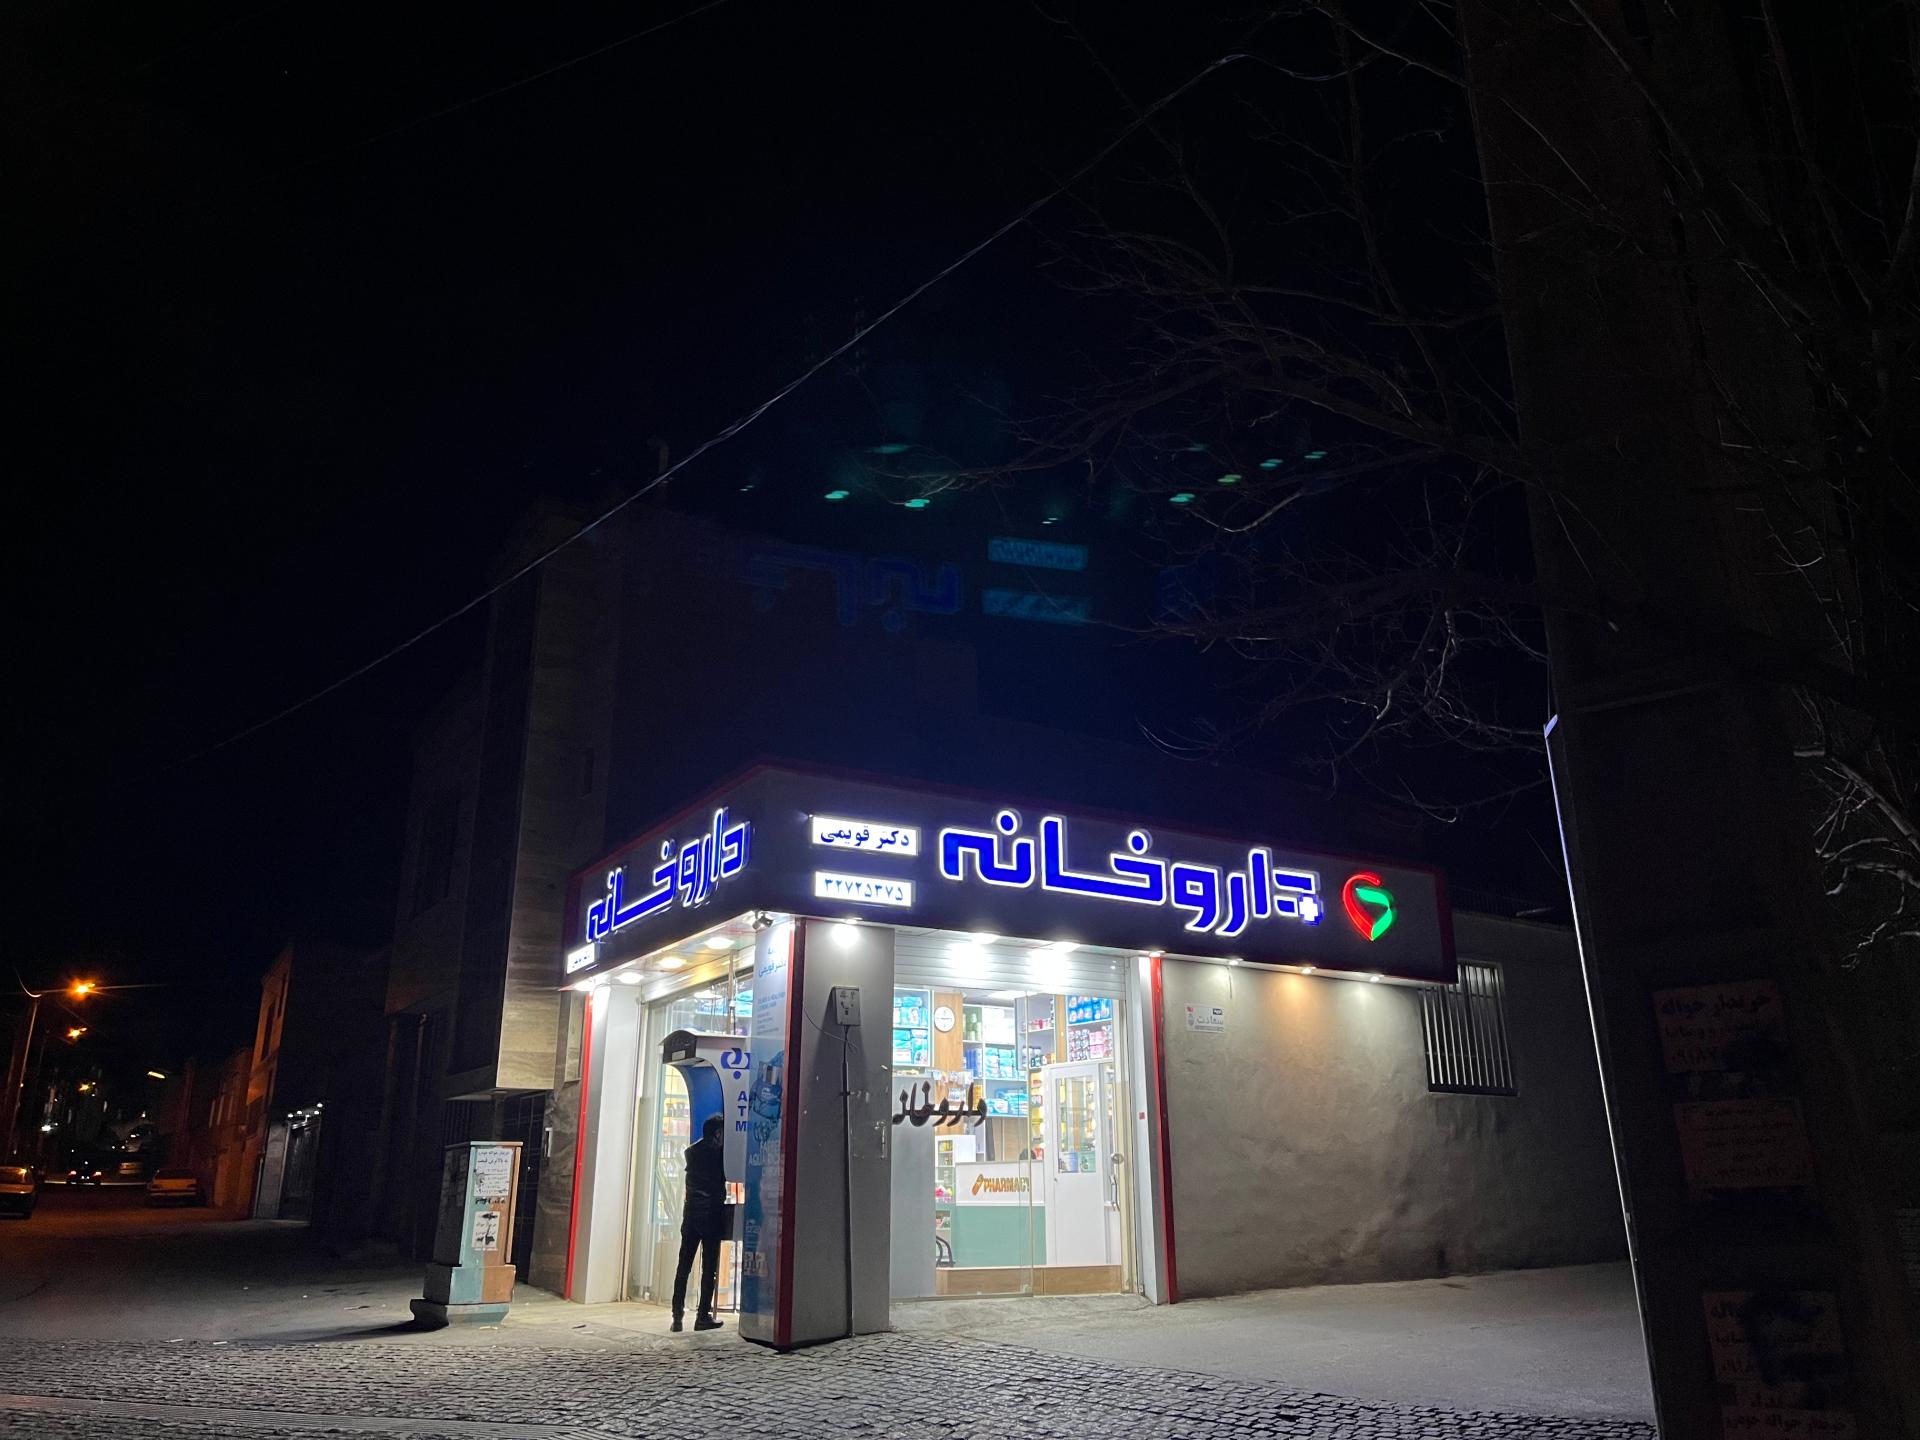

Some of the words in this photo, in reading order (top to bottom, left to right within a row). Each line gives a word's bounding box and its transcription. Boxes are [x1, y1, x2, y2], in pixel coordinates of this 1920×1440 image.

[820, 825, 870, 847] قویمی
[876, 829, 910, 849] دکتر
[586, 808, 747, 942] داروخانه
[939, 809, 1322, 936] داروخانه
[824, 878, 904, 901] ۳۲۷۲۵۳۷۵
[735, 1090, 748, 1132] ATM
